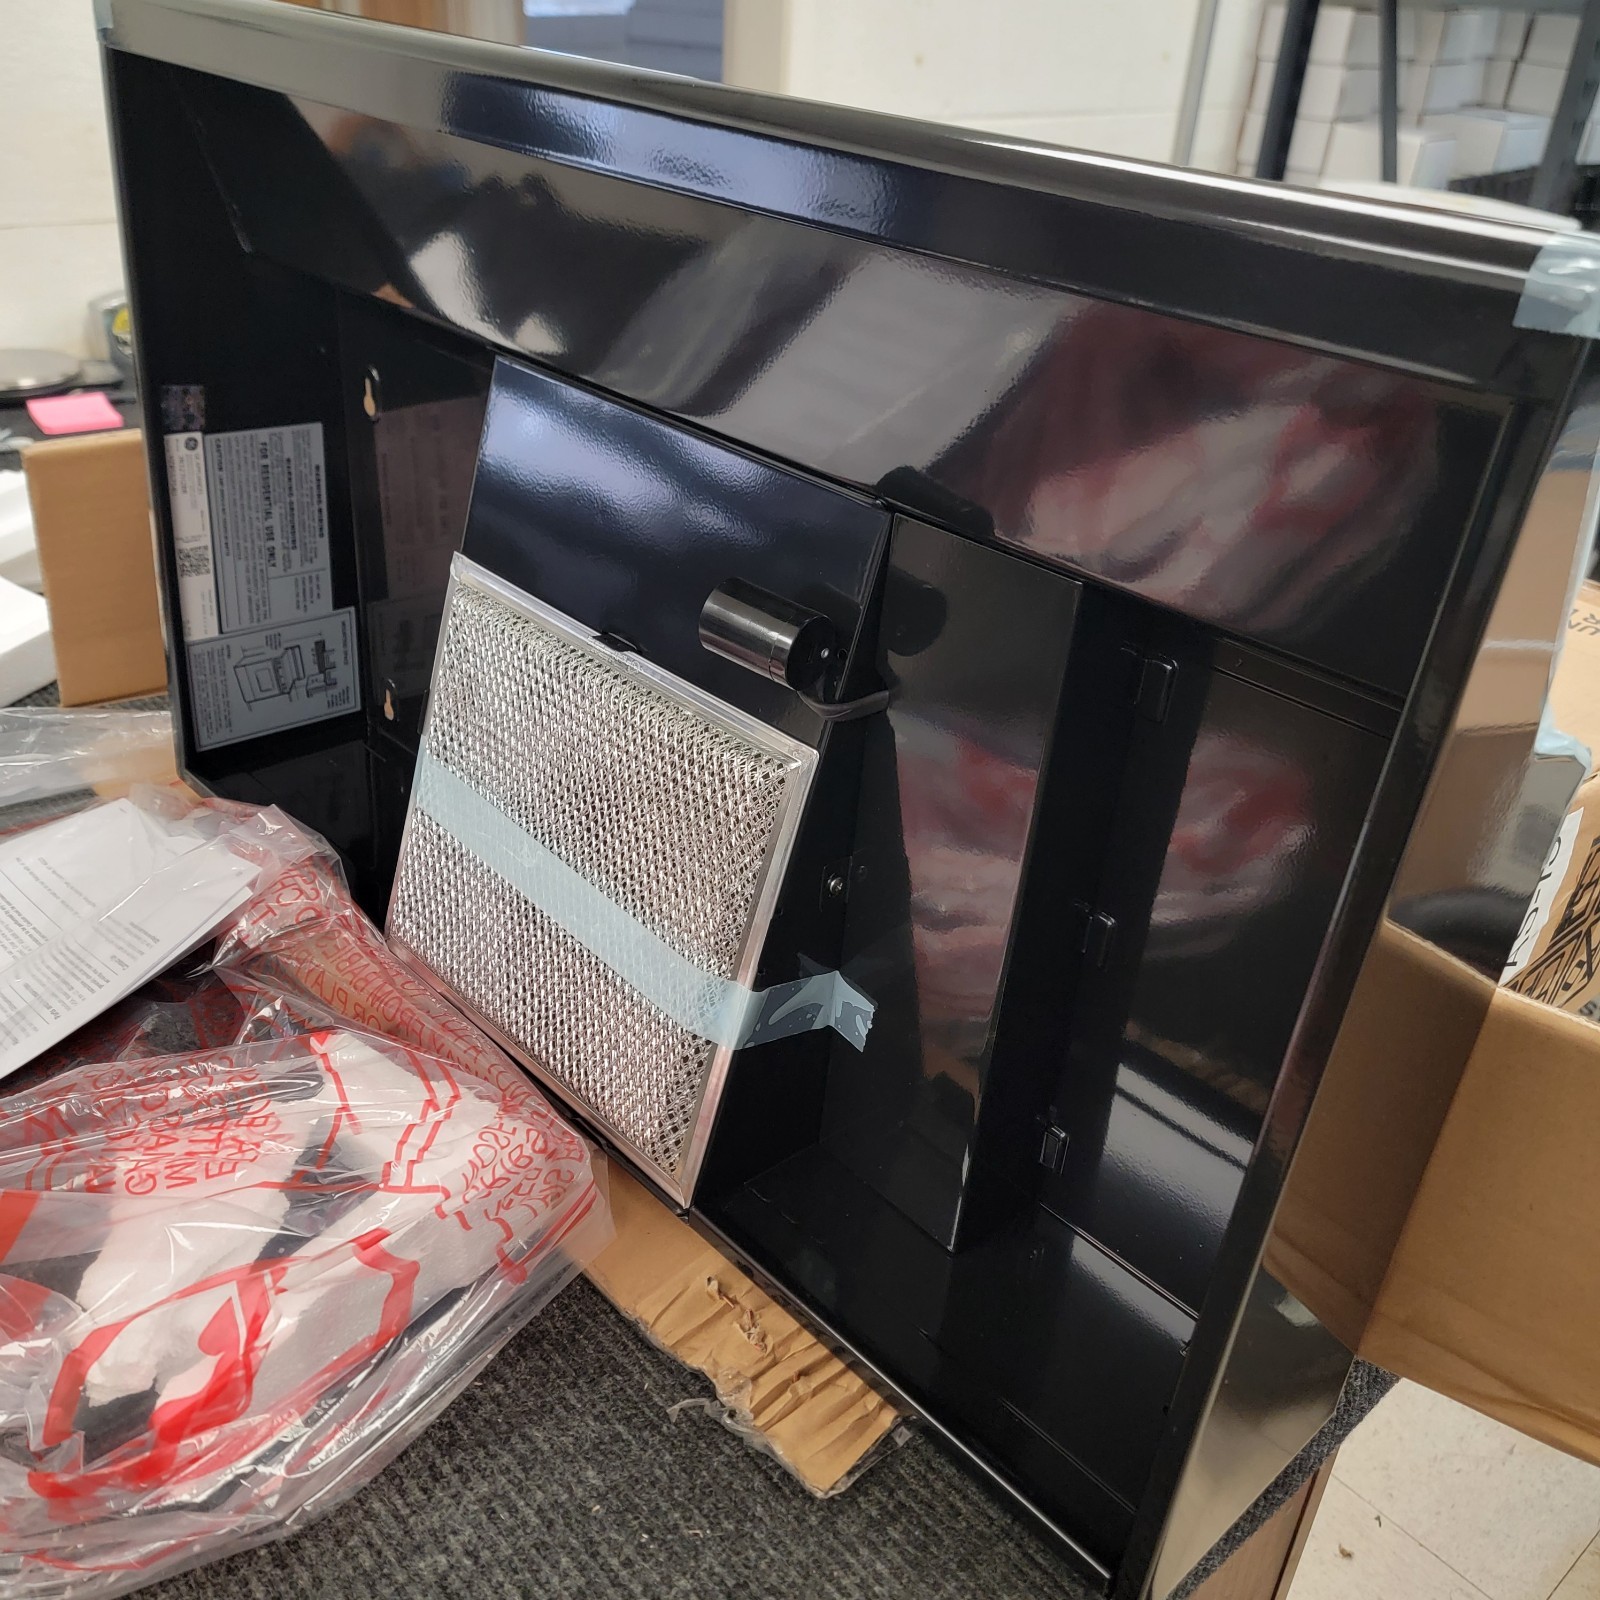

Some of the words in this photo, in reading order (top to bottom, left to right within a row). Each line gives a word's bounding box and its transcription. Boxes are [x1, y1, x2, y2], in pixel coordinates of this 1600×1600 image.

[259, 441, 268, 460] FOR
[260, 463, 272, 521] RESIDENTIAL
[265, 524, 274, 542] USE
[266, 545, 276, 568] ONLY
